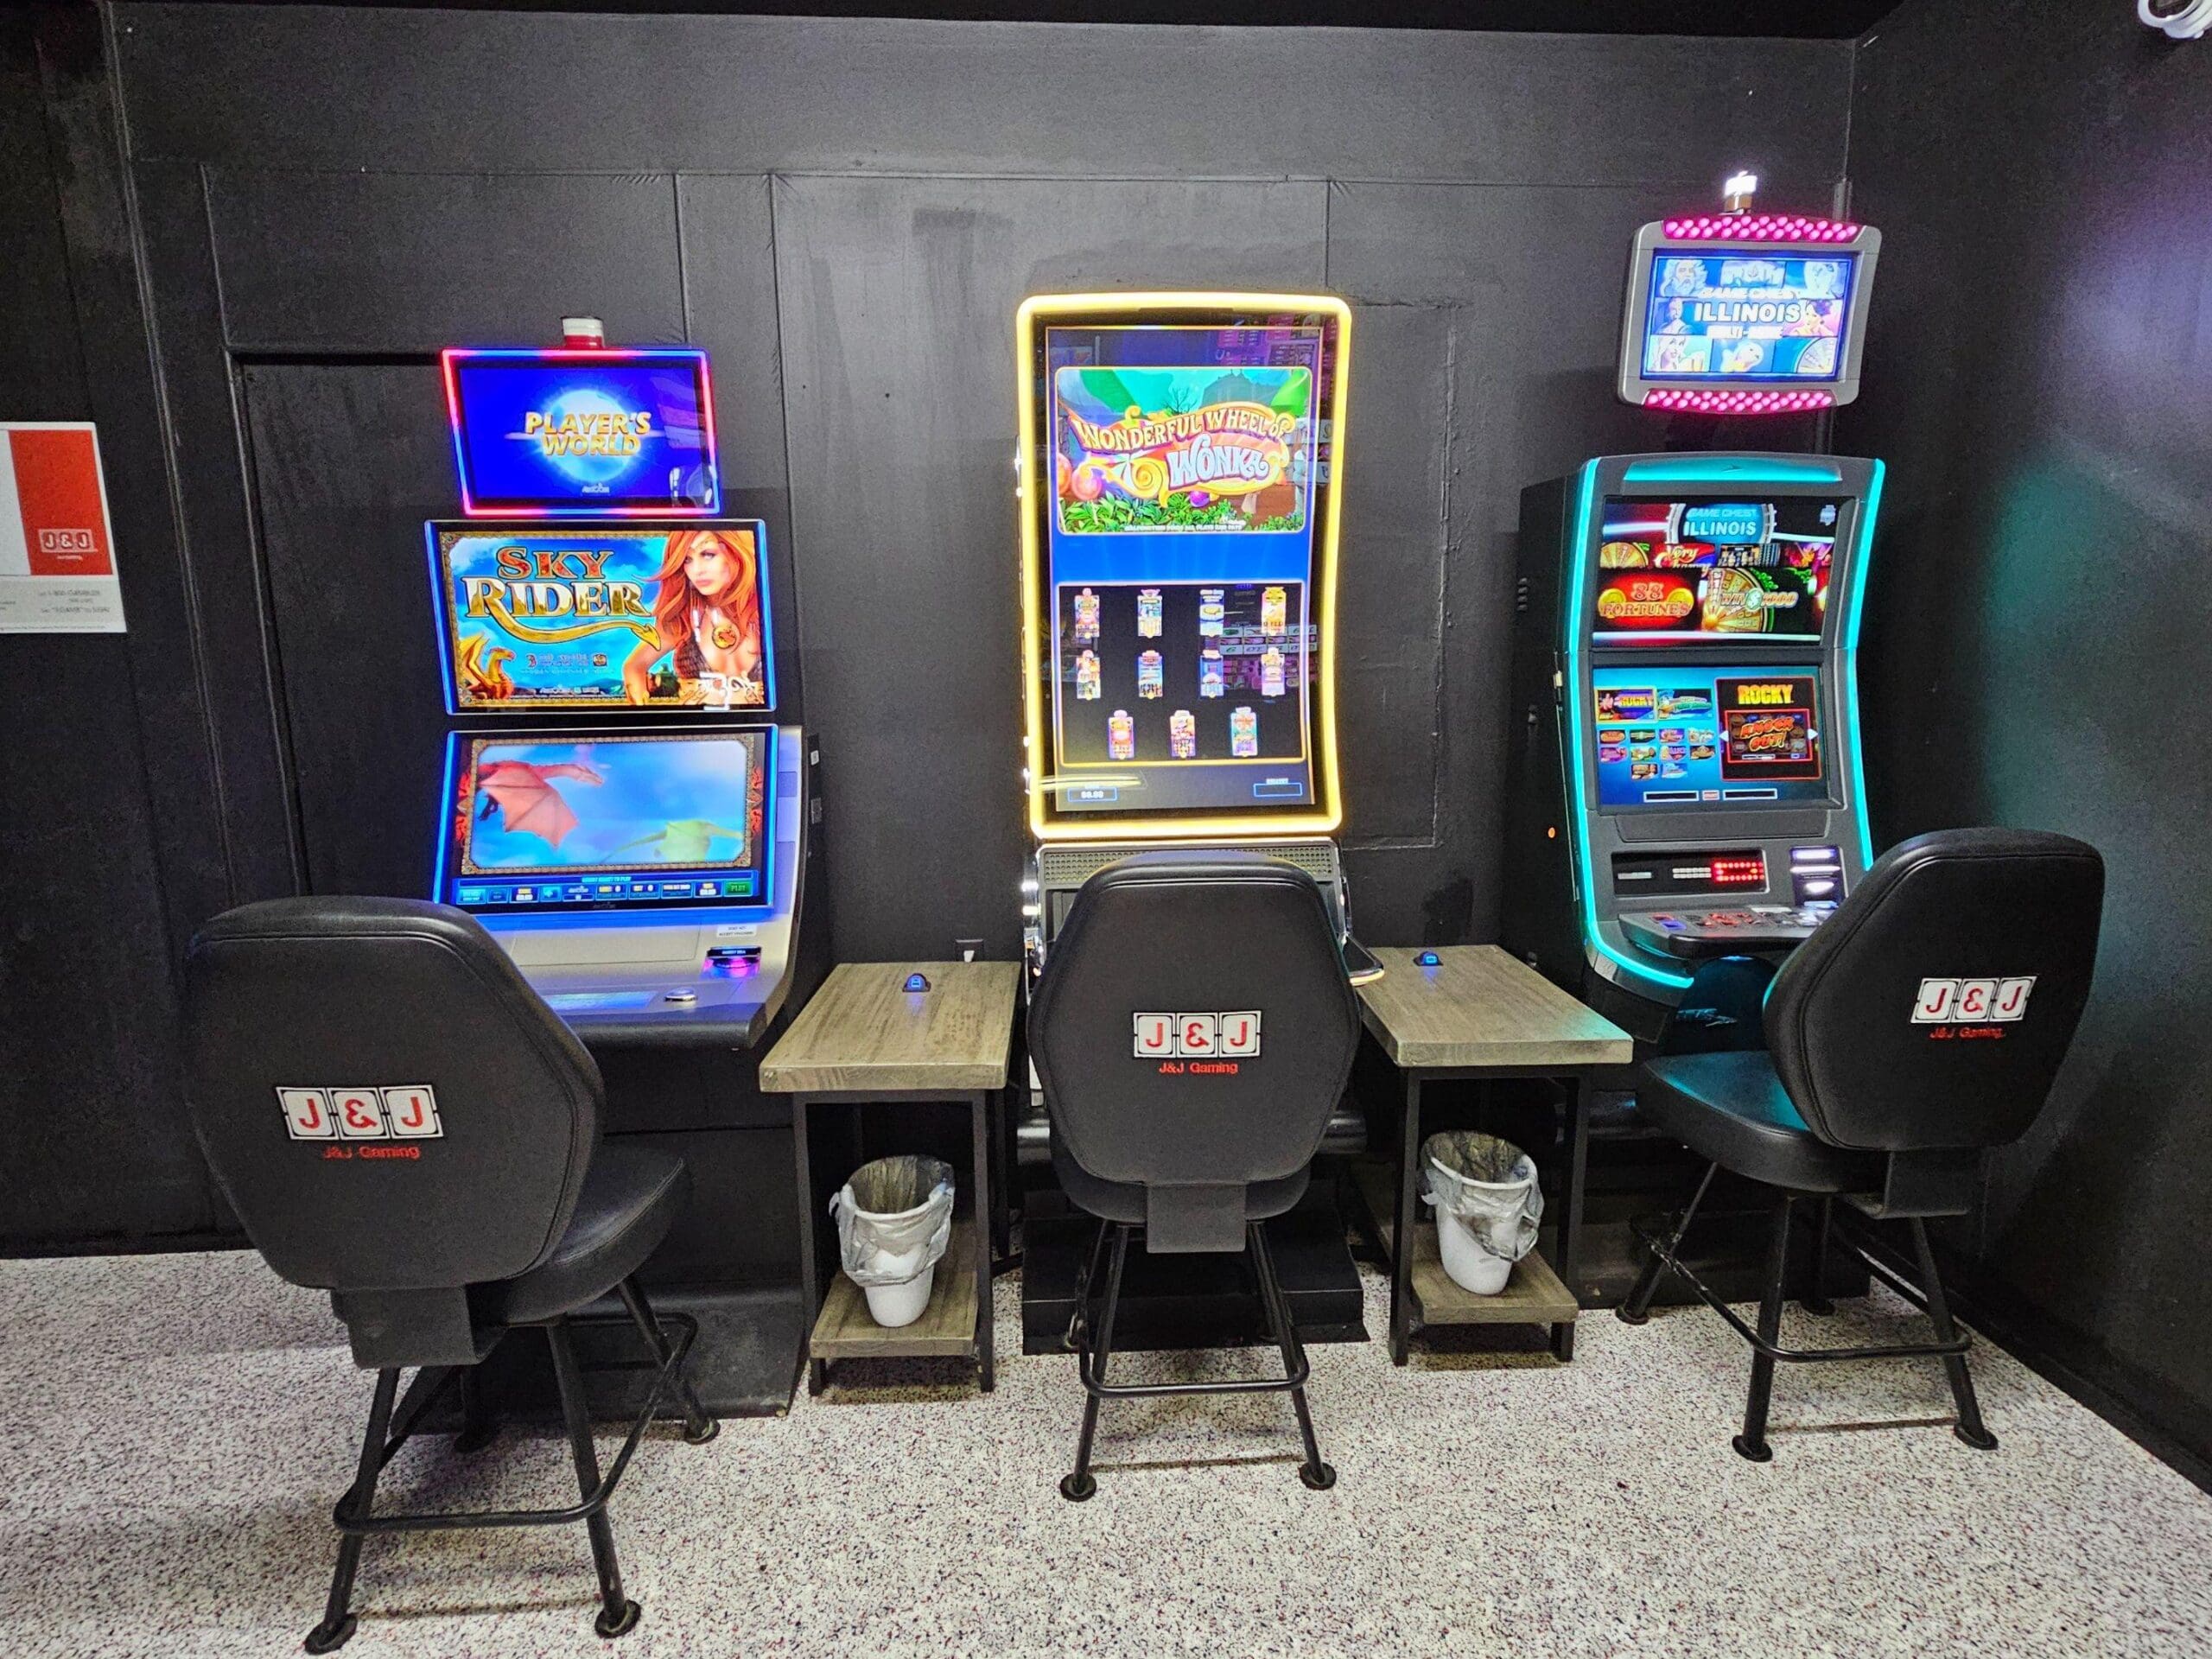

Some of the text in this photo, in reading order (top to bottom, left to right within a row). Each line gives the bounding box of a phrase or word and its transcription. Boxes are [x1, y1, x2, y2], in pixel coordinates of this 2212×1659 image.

[1694, 302, 1801, 323] ILLINOIS
[524, 411, 652, 435] PLAYER'S
[1072, 414, 1203, 450] WONDERFUL
[1205, 408, 1265, 435] WHEEL
[541, 435, 641, 456] WORLD
[1167, 435, 1268, 487] WONKA
[1686, 508, 1758, 518] GAME CHEST
[1683, 522, 1757, 536] ILLINOIS
[43, 531, 90, 550] J&J
[496, 547, 613, 580] SKY
[462, 576, 653, 618] RIDER
[1631, 582, 1664, 601] 88
[1603, 602, 1691, 616] FORTUNES
[1738, 684, 1794, 705] ROCKY
[1740, 717, 1795, 740] KNOCK
[1923, 984, 2025, 1014] J&J
[1143, 1020, 1249, 1048] J&J
[1159, 1062, 1239, 1074] J&J Gaming
[296, 1095, 425, 1131] J&J
[358, 1145, 421, 1160] Gaming
